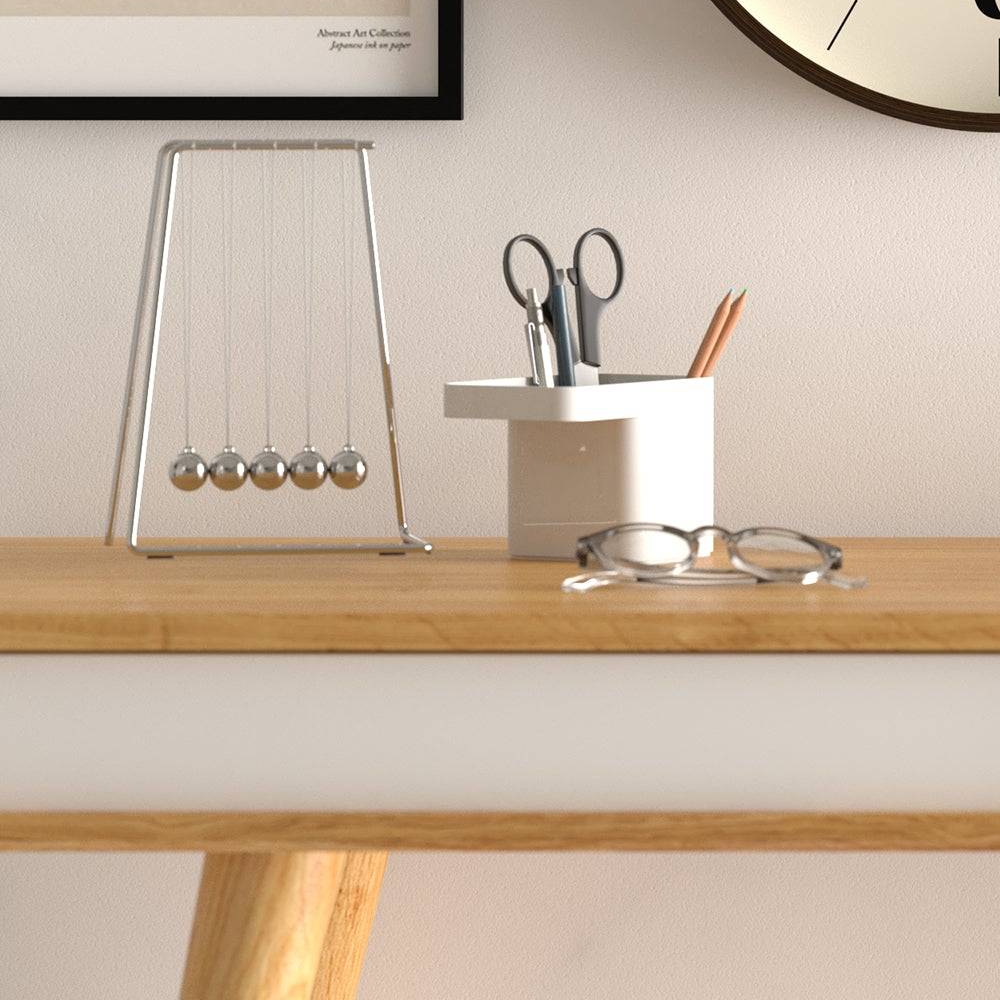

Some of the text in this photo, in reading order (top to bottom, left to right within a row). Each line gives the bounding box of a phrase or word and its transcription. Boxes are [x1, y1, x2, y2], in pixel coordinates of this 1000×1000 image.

[317, 28, 411, 38] Abstract Art Collection
[329, 40, 363, 51] Japanese
[365, 40, 377, 49] ink
[389, 42, 412, 52] paper
